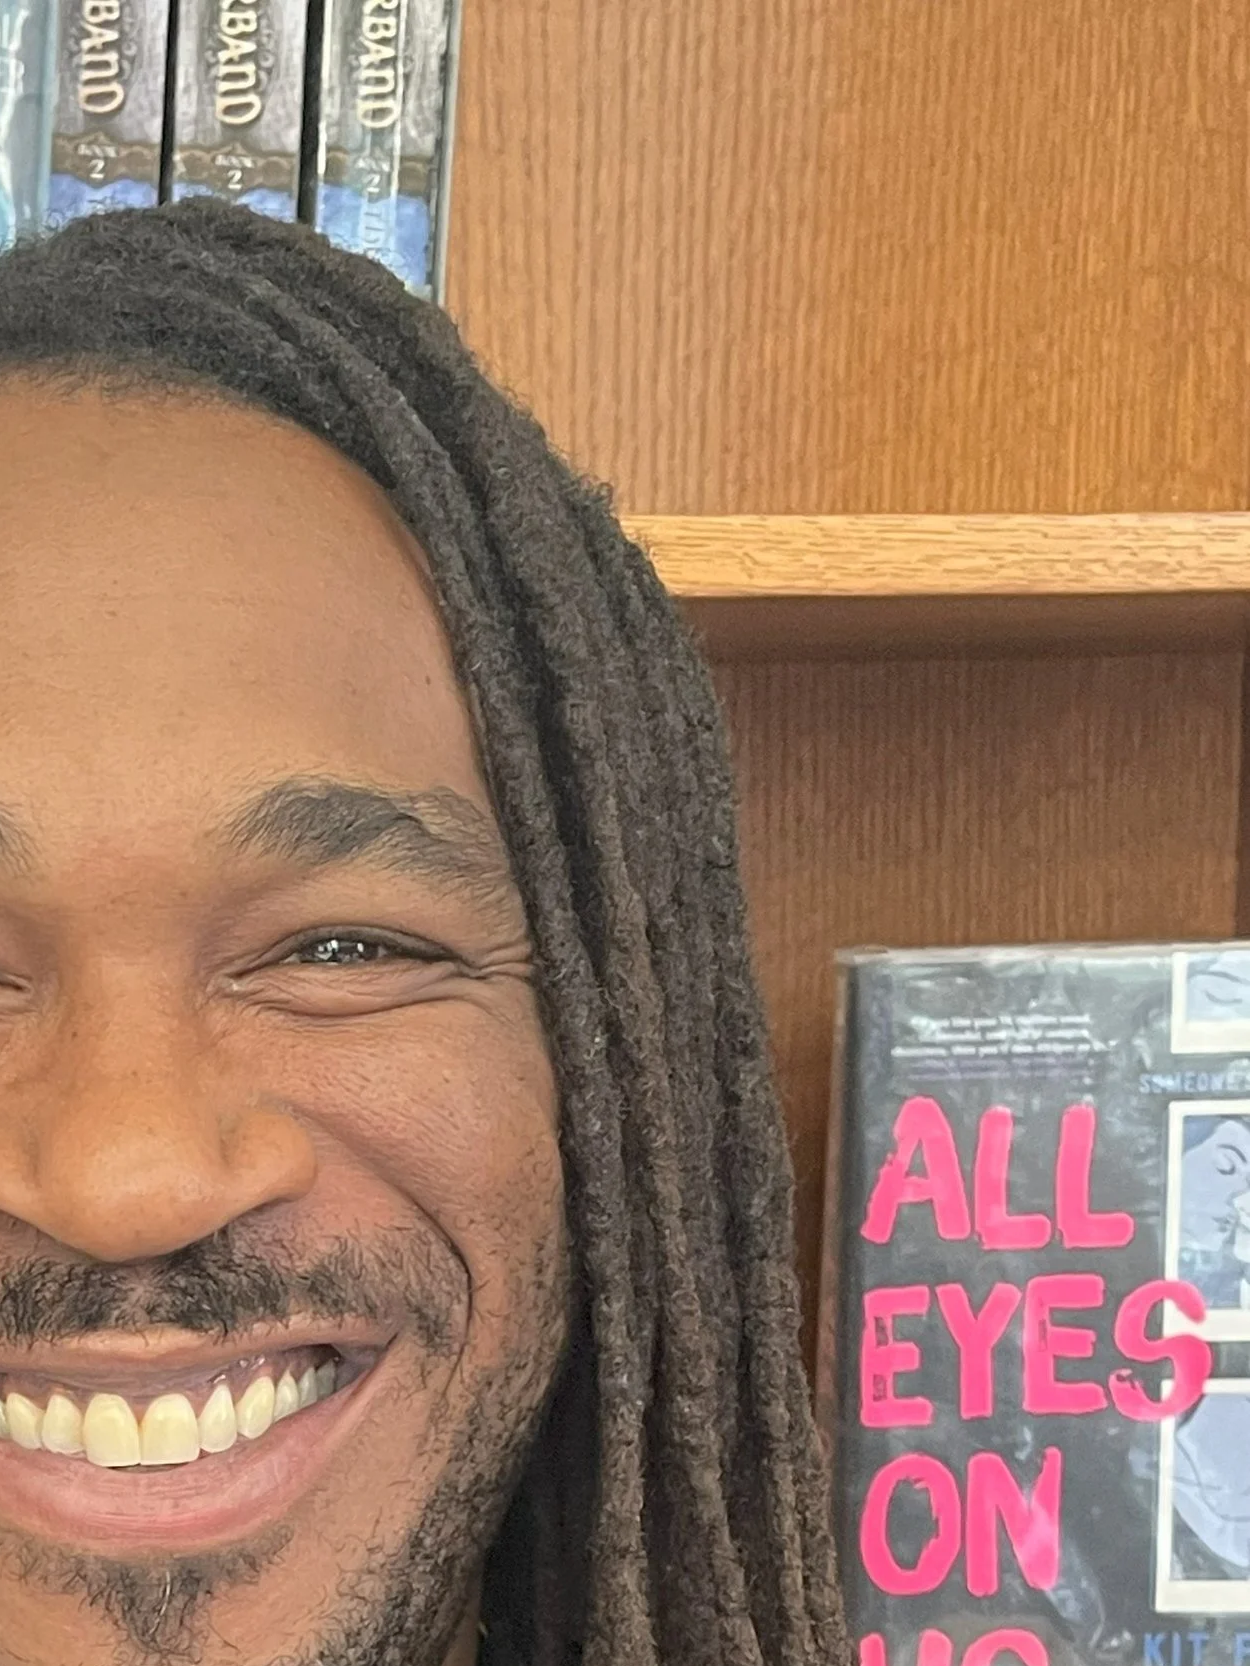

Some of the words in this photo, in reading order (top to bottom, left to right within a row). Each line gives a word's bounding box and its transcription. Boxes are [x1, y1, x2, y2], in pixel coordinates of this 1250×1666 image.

[90, 159, 105, 178] 2
[227, 170, 242, 189] 2
[860, 1095, 1135, 1250] ALL
[860, 1273, 1212, 1428] EYES
[860, 1446, 1063, 1597] ON
